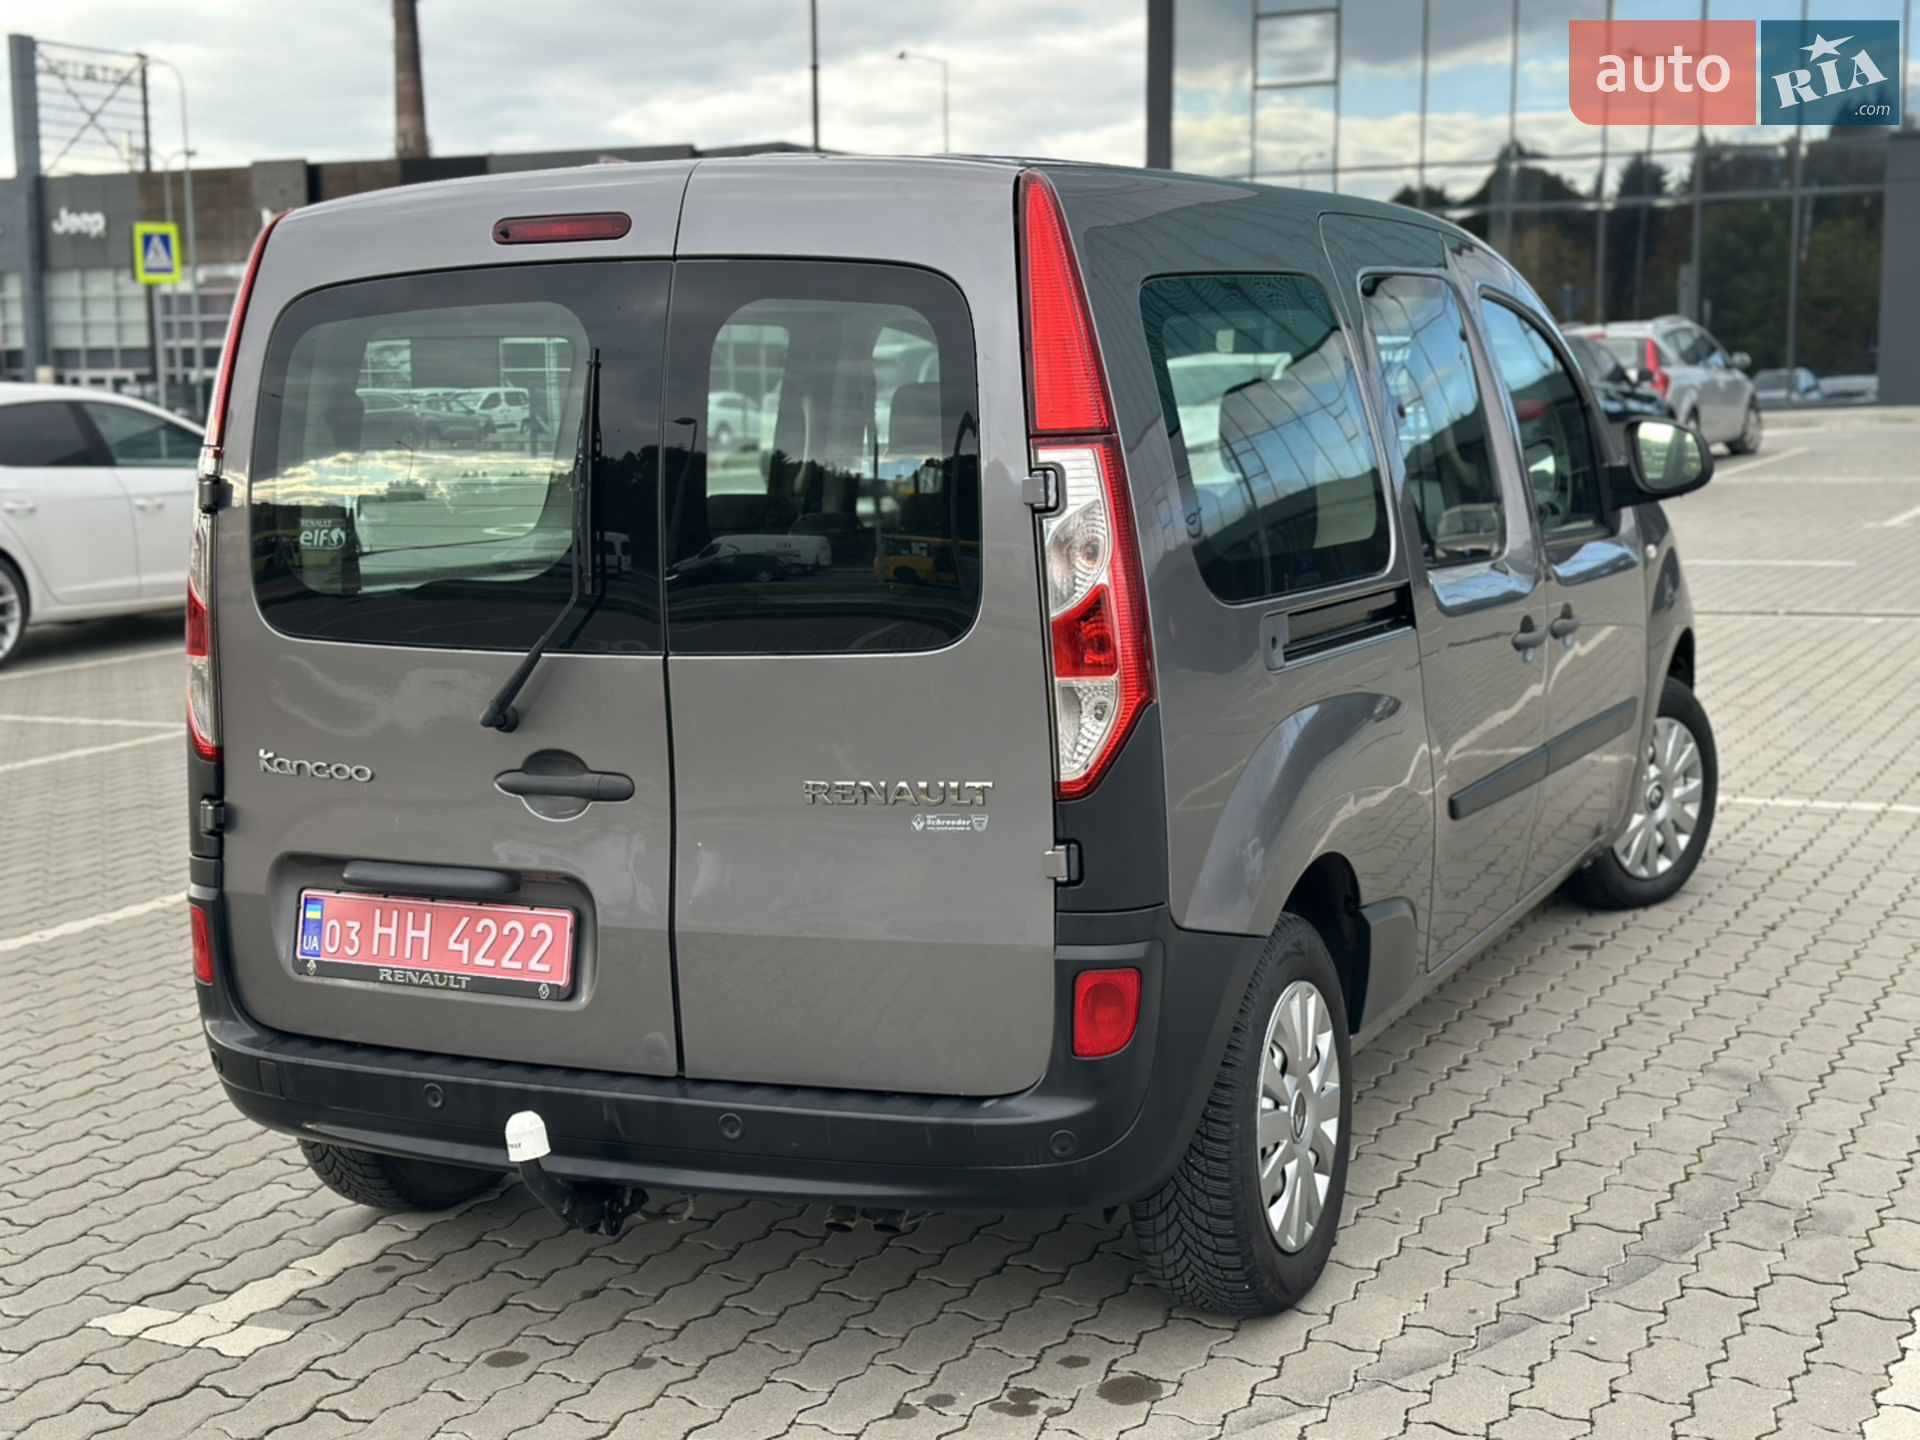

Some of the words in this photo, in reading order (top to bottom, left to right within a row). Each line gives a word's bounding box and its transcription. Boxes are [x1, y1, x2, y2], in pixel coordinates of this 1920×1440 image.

[51, 206, 107, 239] Jeep
[300, 519, 332, 527] RENAULT
[299, 528, 329, 547] elf
[803, 779, 994, 807] RENAULT
[302, 933, 320, 952] UA
[323, 917, 362, 957] 03
[447, 915, 555, 973] 4222
[378, 968, 472, 990] RENAULT
